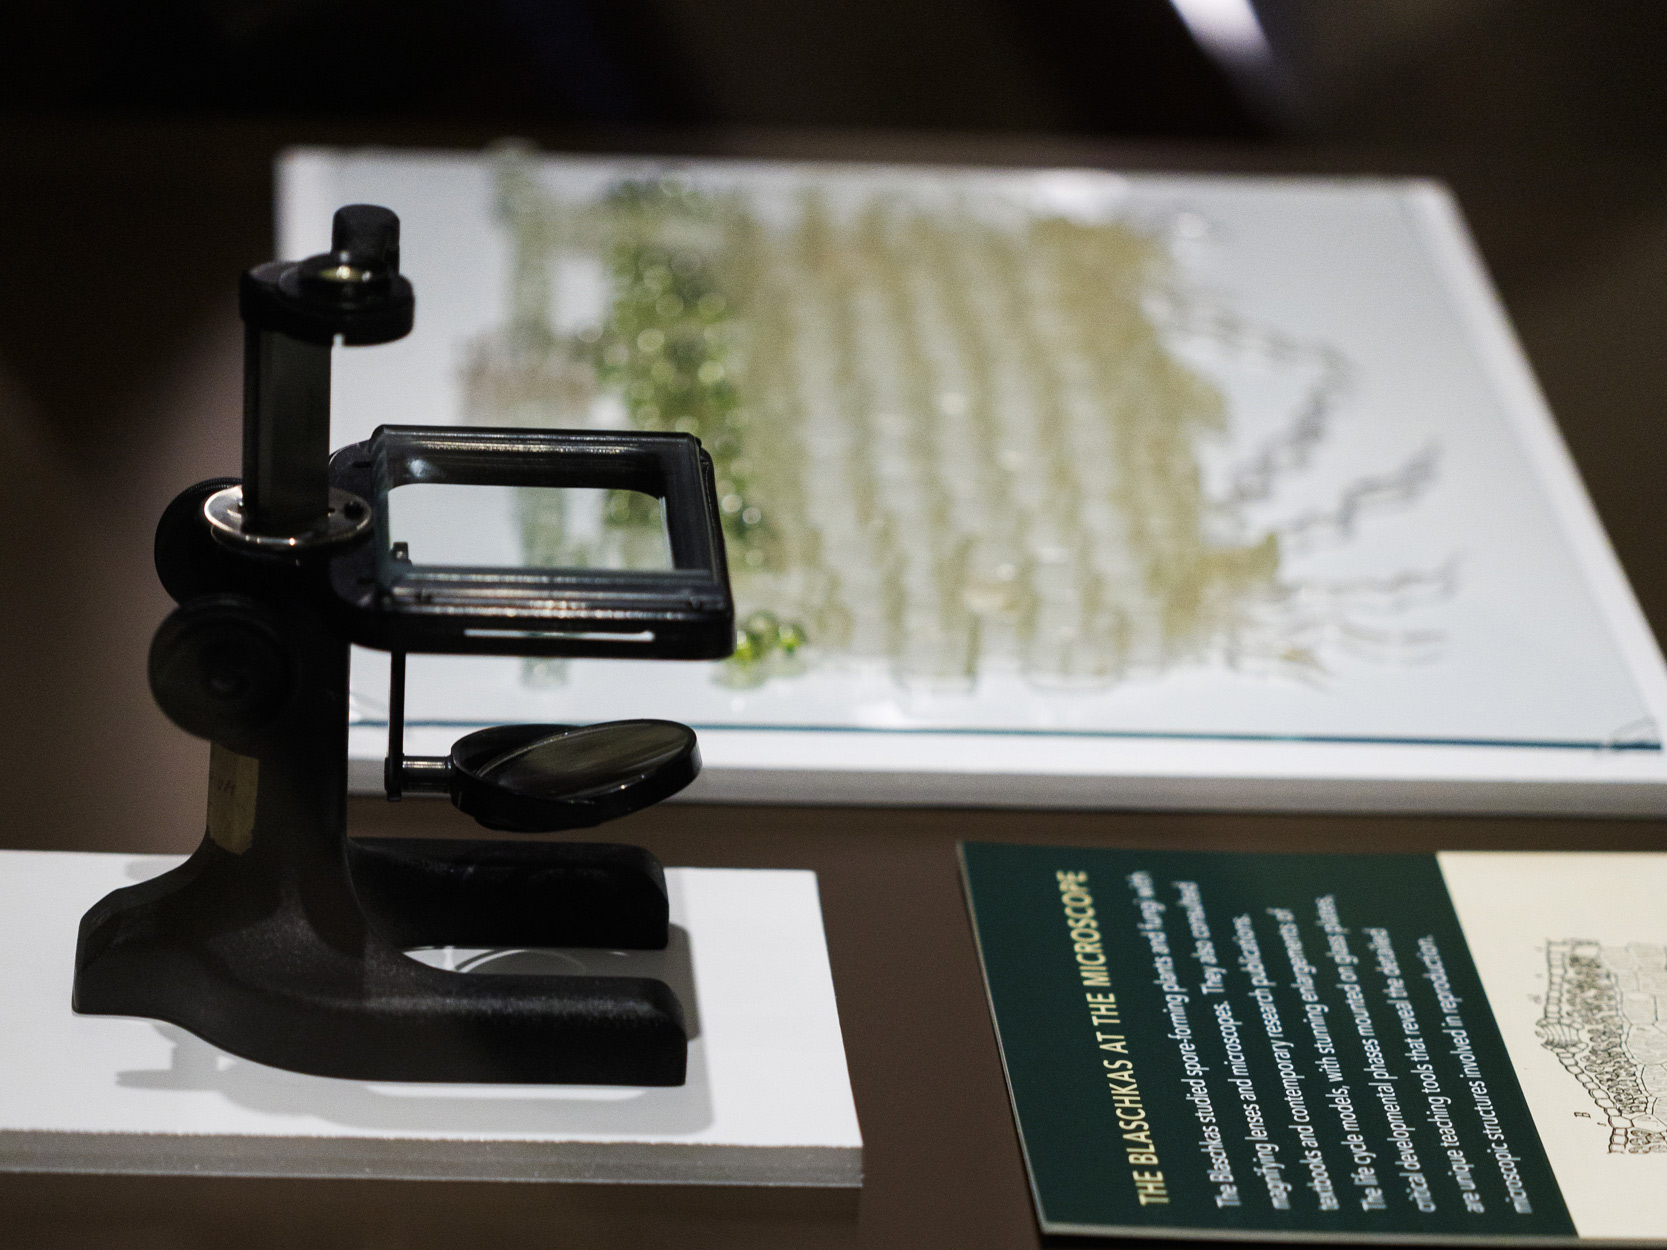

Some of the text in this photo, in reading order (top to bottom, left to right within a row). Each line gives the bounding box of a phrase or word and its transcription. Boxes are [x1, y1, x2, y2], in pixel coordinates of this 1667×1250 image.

[1192, 938, 1218, 966] also
[1326, 934, 1359, 966] glass
[1337, 965, 1358, 983] on
[1200, 965, 1227, 995] They
[1248, 987, 1284, 1038] research
[1336, 983, 1375, 1037] mounted
[1056, 870, 1169, 1206] THE BLASCHKAS AT THE MICROSCOPE
[1129, 871, 1241, 1208] The Blaschkas studied spore-forming plants and fungi with
[1213, 1000, 1249, 1076] microscopes.
[1267, 907, 1386, 1212] The life cycle models, with stunning enlargements of
[1361, 1038, 1398, 1080] phases
[1227, 1078, 1257, 1102] and
[1270, 1039, 1310, 1123] contemporary
[1364, 927, 1485, 1213] are unique teaching tools that reveal the detailed
[1417, 936, 1532, 1214] microscopic structures involved in reproduction.
[1242, 1103, 1269, 1141] lenses
[1288, 1125, 1319, 1148] and
[1368, 1082, 1421, 1170] developmental
[1252, 1143, 1293, 1210] magnifying
[1299, 1149, 1340, 1211] textbooks
[1399, 1172, 1437, 1212] critical
